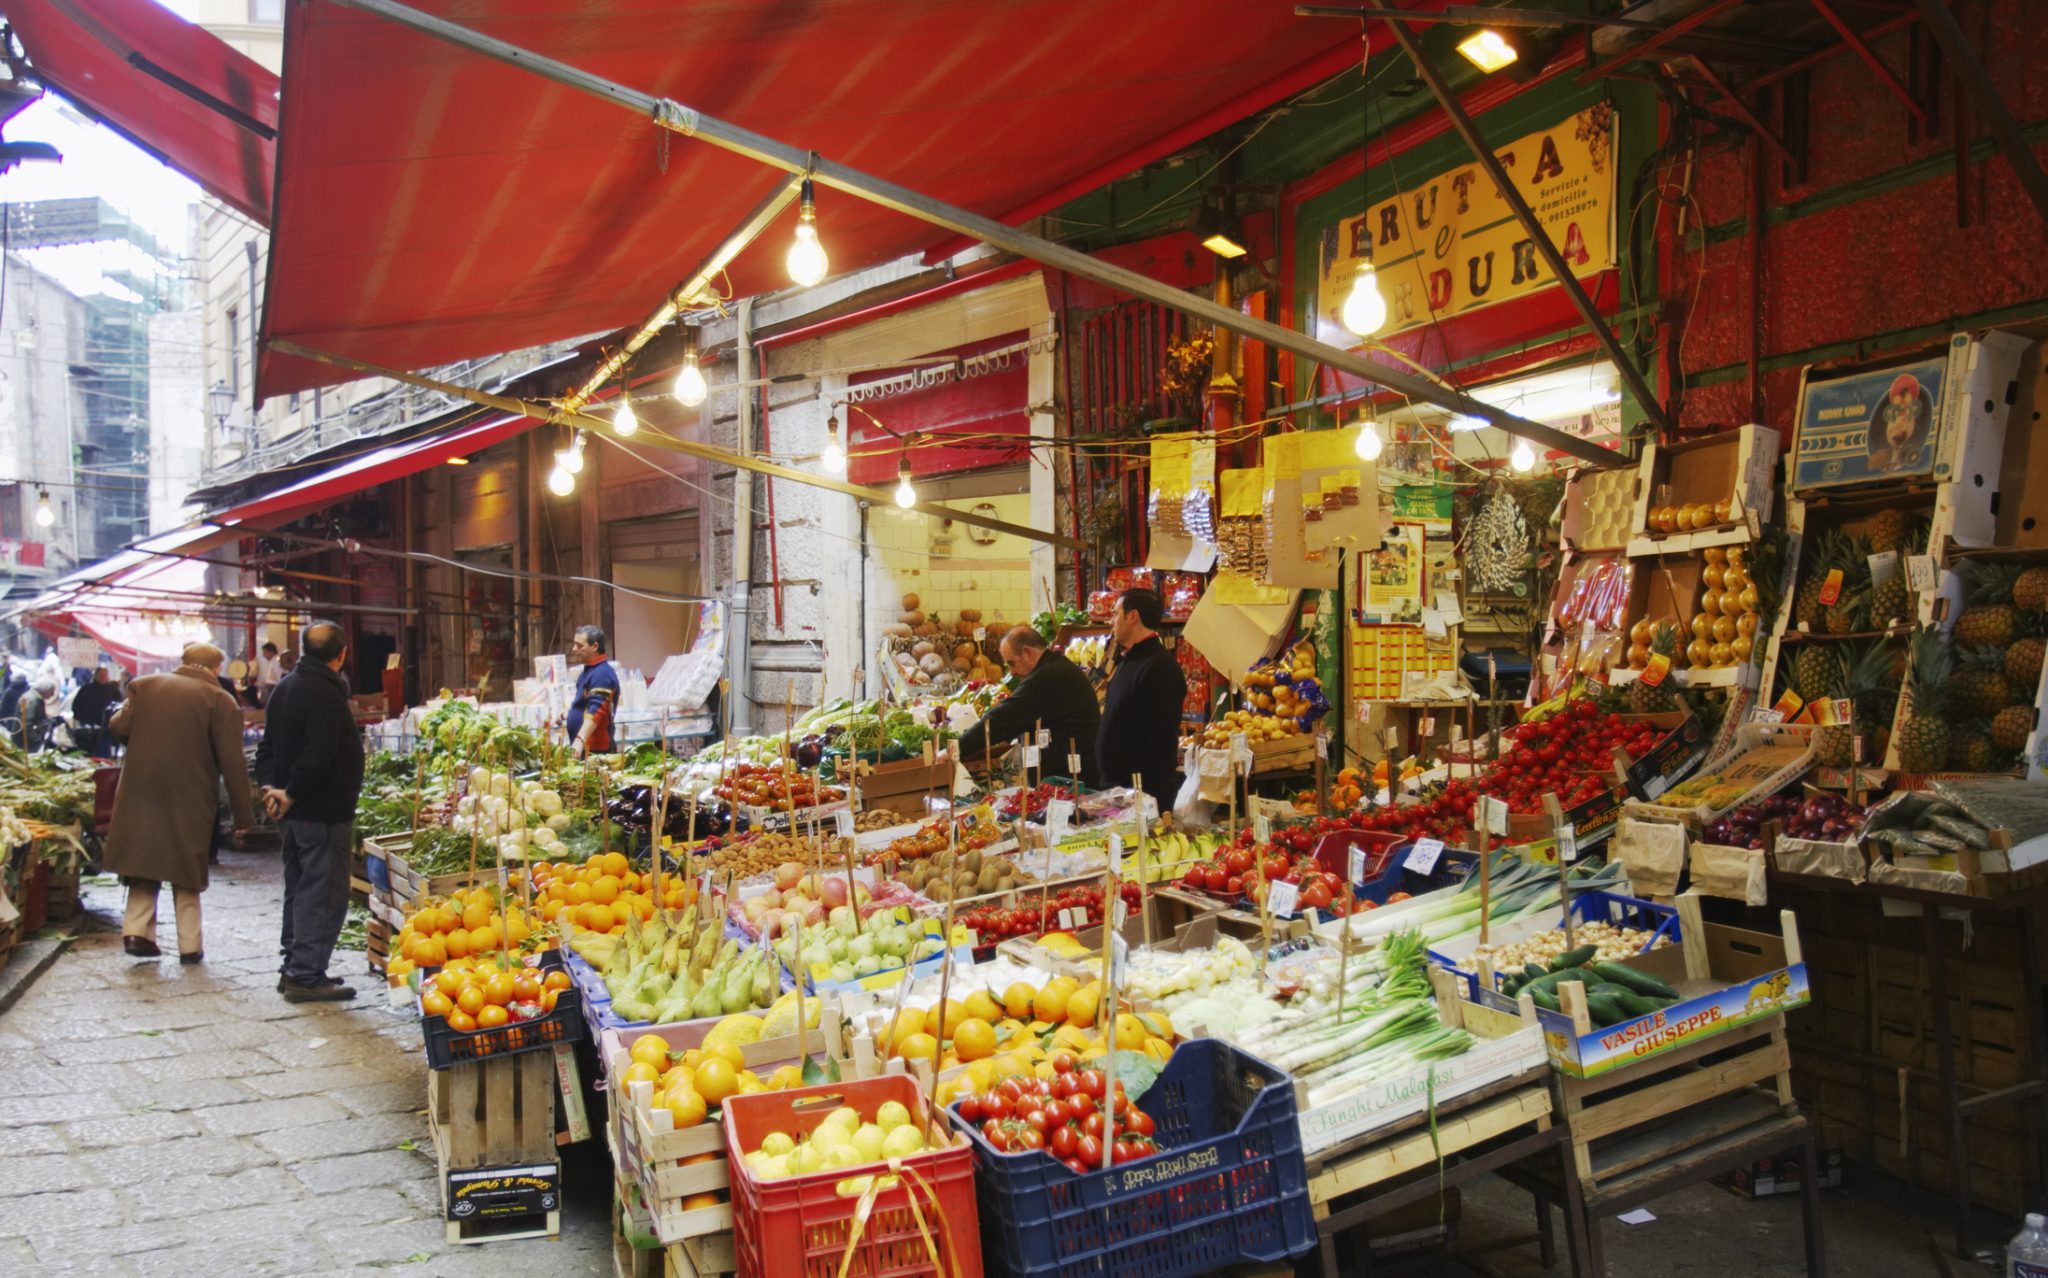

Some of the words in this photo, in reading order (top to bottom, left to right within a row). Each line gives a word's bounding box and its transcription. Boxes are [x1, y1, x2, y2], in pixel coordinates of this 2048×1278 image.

[1540, 177, 1580, 199] Servizio
[1540, 189, 1587, 212] domicilio
[1548, 198, 1598, 223] 091328076
[1434, 224, 1458, 261] e
[1330, 222, 1590, 324] RDURA
[1714, 727, 1733, 759] ONTE
[763, 809, 811, 830] Melida
[1600, 1011, 1667, 1051] VASILE
[1633, 1005, 1723, 1057] GIUSEPPE
[1308, 1099, 1372, 1135] Funghi
